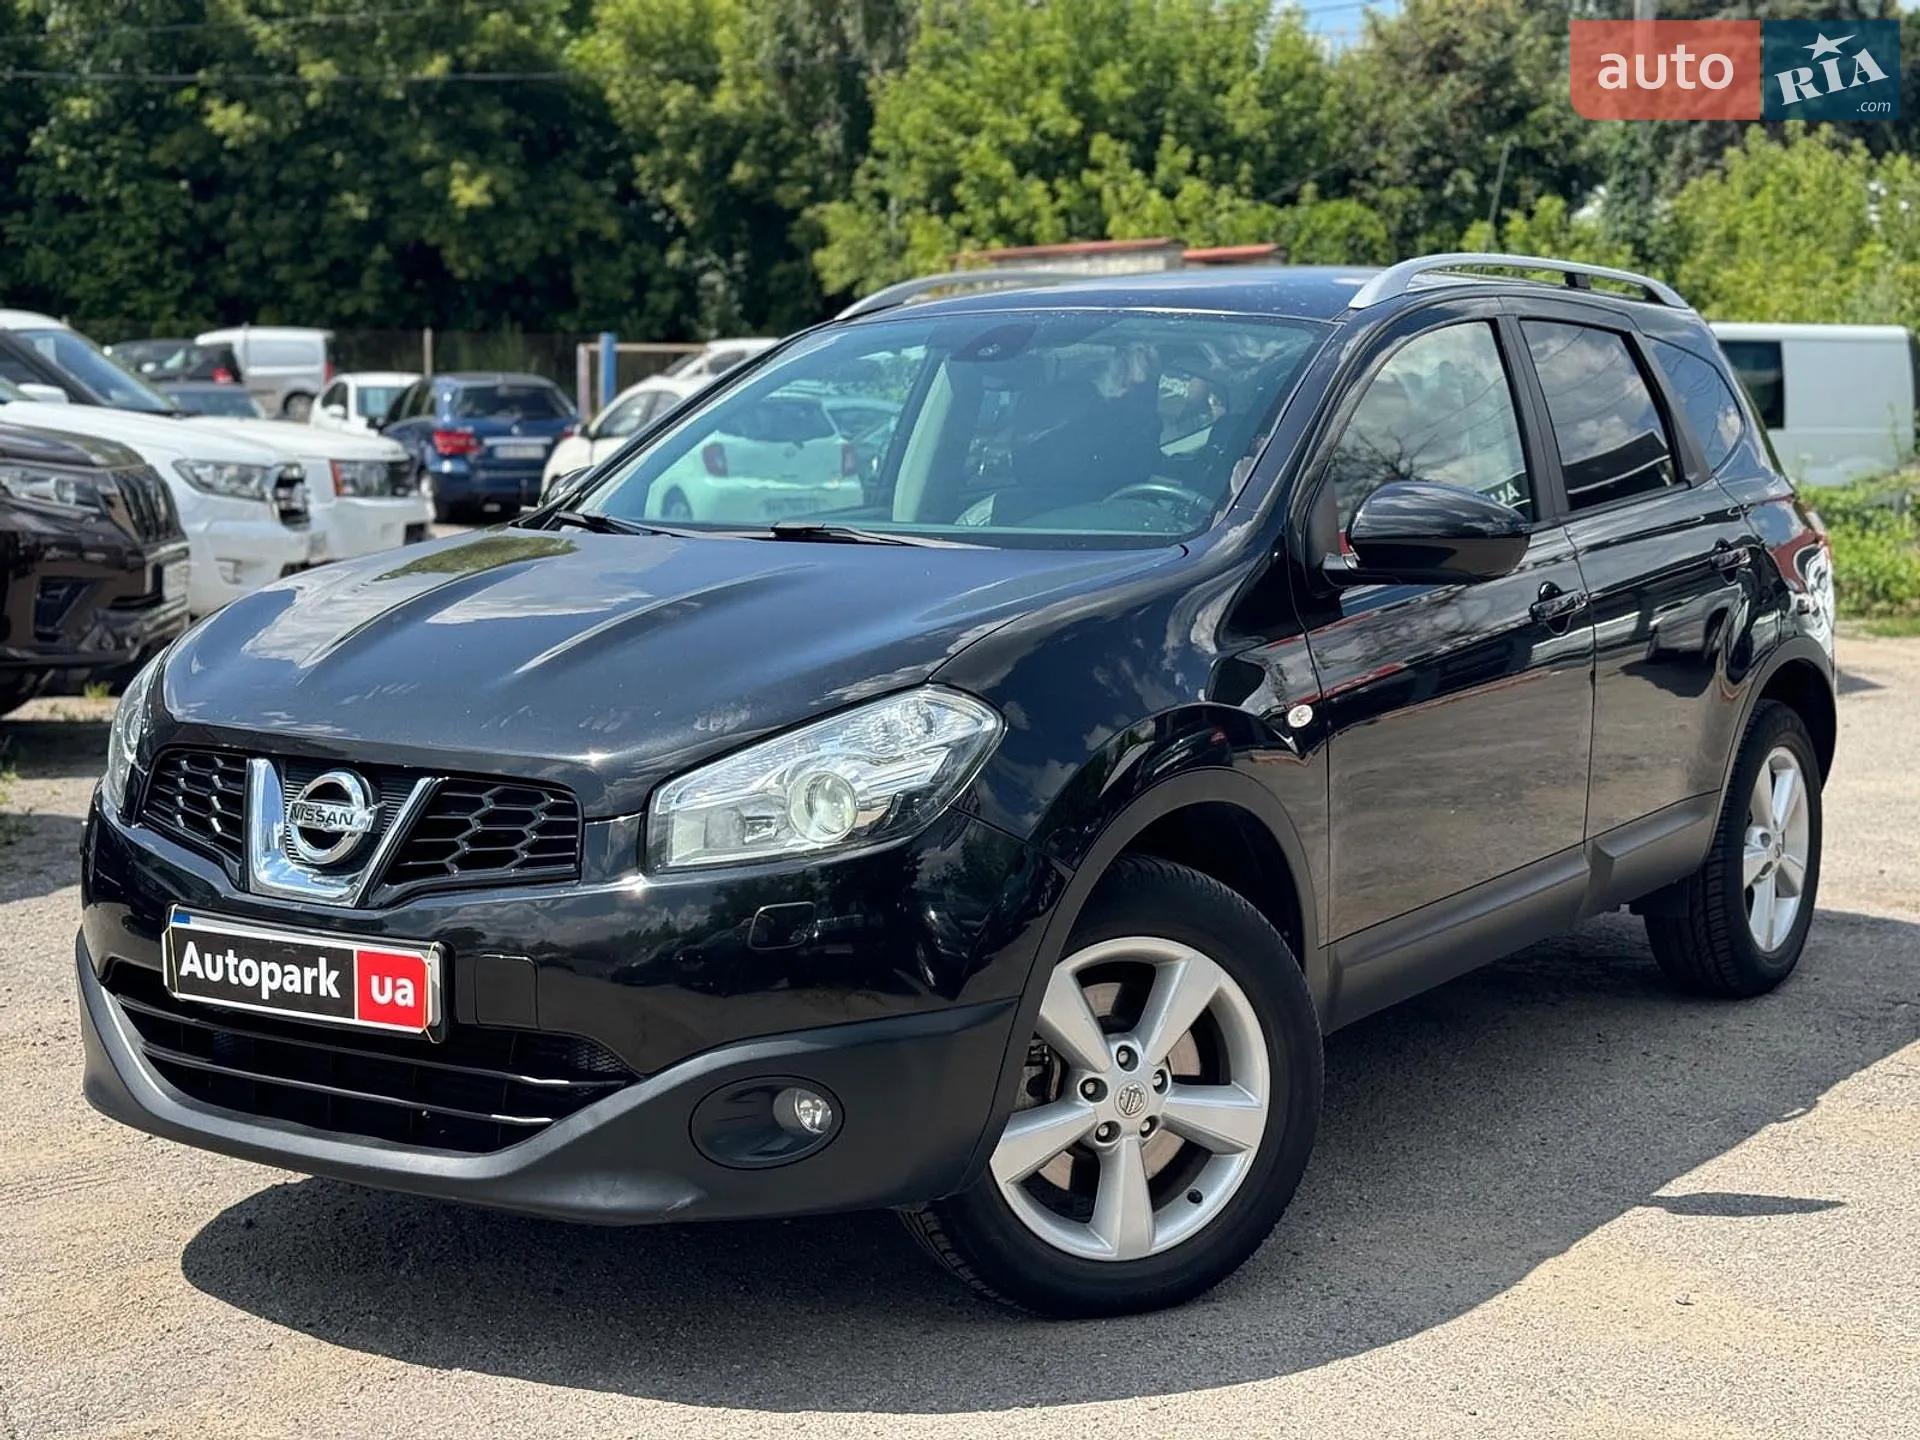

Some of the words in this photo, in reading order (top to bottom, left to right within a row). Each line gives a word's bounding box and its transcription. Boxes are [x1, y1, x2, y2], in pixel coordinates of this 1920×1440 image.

[289, 802, 355, 826] NISSAN
[179, 941, 341, 1000] Autopark
[370, 974, 416, 1008] ua
